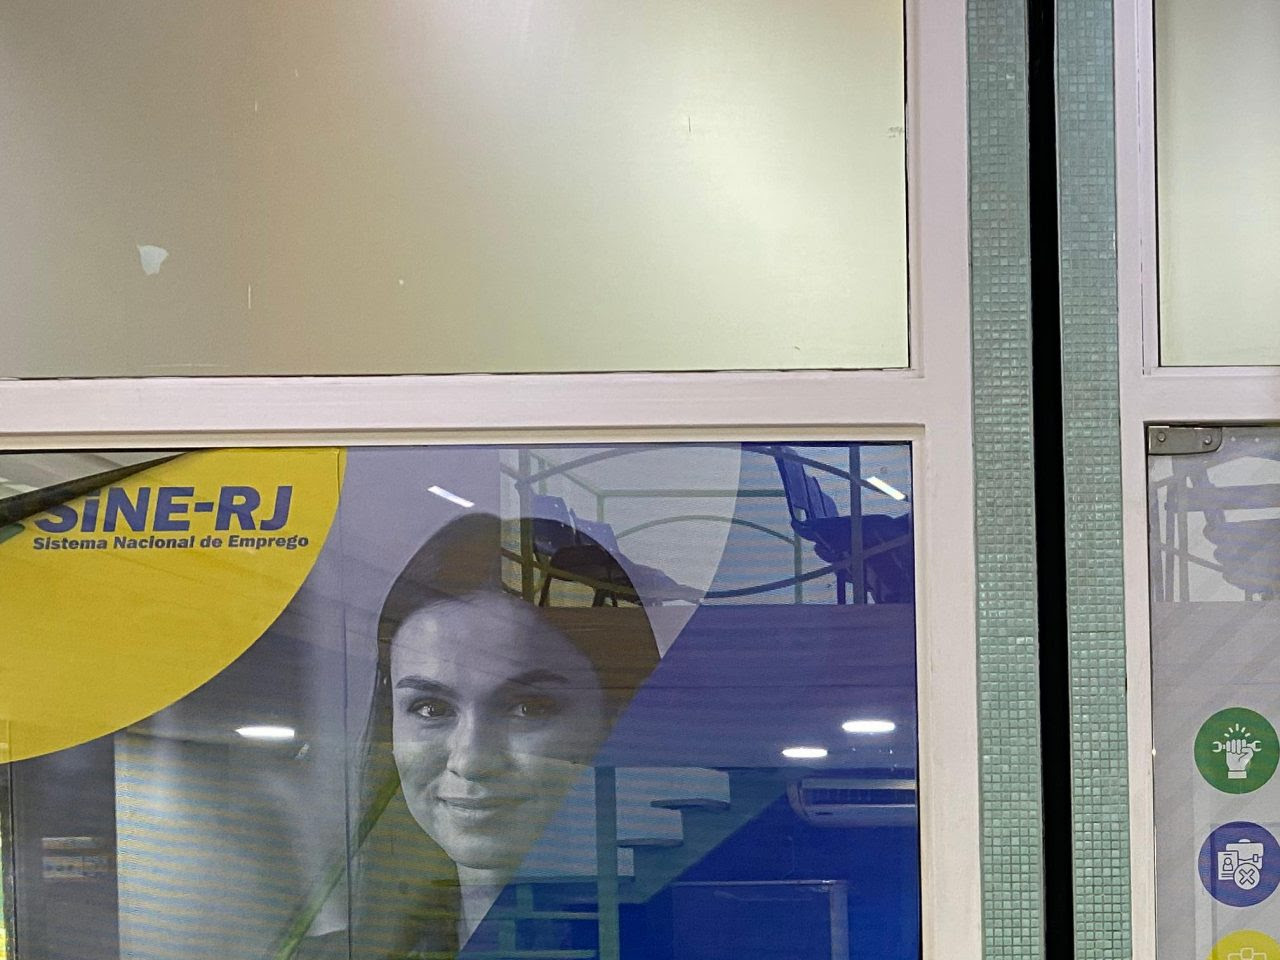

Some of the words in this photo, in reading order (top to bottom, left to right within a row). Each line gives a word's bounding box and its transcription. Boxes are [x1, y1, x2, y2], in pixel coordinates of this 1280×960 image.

[33, 537, 108, 550] Sistema
[113, 536, 195, 549] Nacional
[200, 535, 222, 548] de
[228, 535, 309, 550] Emprego
